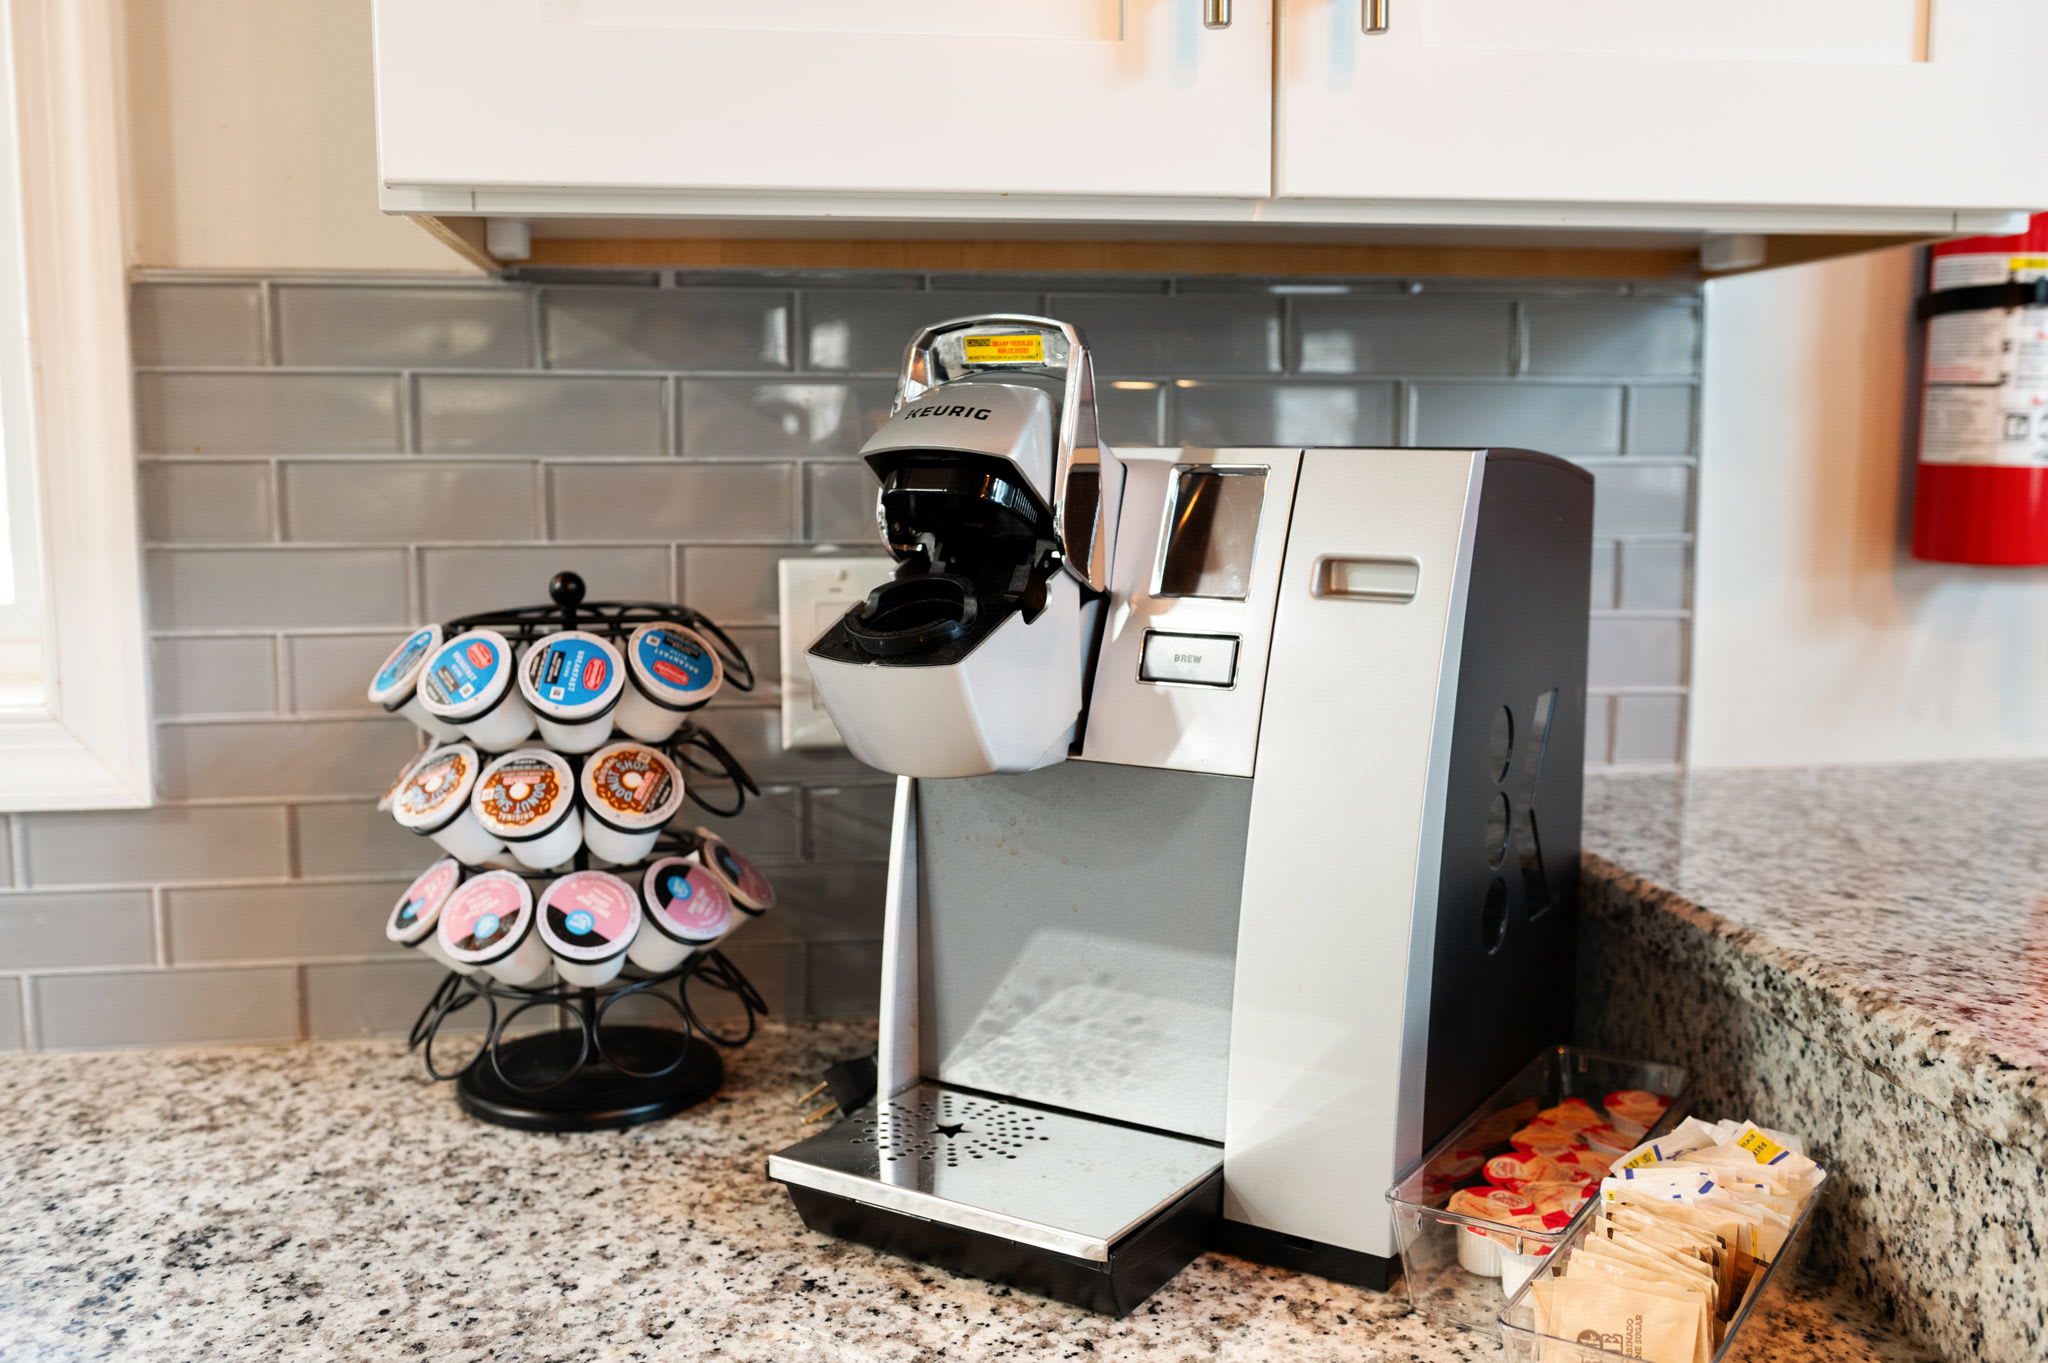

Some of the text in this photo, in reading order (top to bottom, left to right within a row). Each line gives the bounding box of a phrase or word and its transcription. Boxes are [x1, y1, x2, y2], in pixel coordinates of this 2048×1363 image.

[904, 405, 992, 421] KEURIG
[567, 650, 585, 692] BREAKFAST
[1174, 653, 1202, 664] BREW
[616, 760, 650, 772] SHOP
[514, 783, 546, 814] DONUT
[607, 768, 633, 802] DONUT
[1626, 1318, 1634, 1357] RBINADO
[1635, 1314, 1643, 1344] SUGAR
